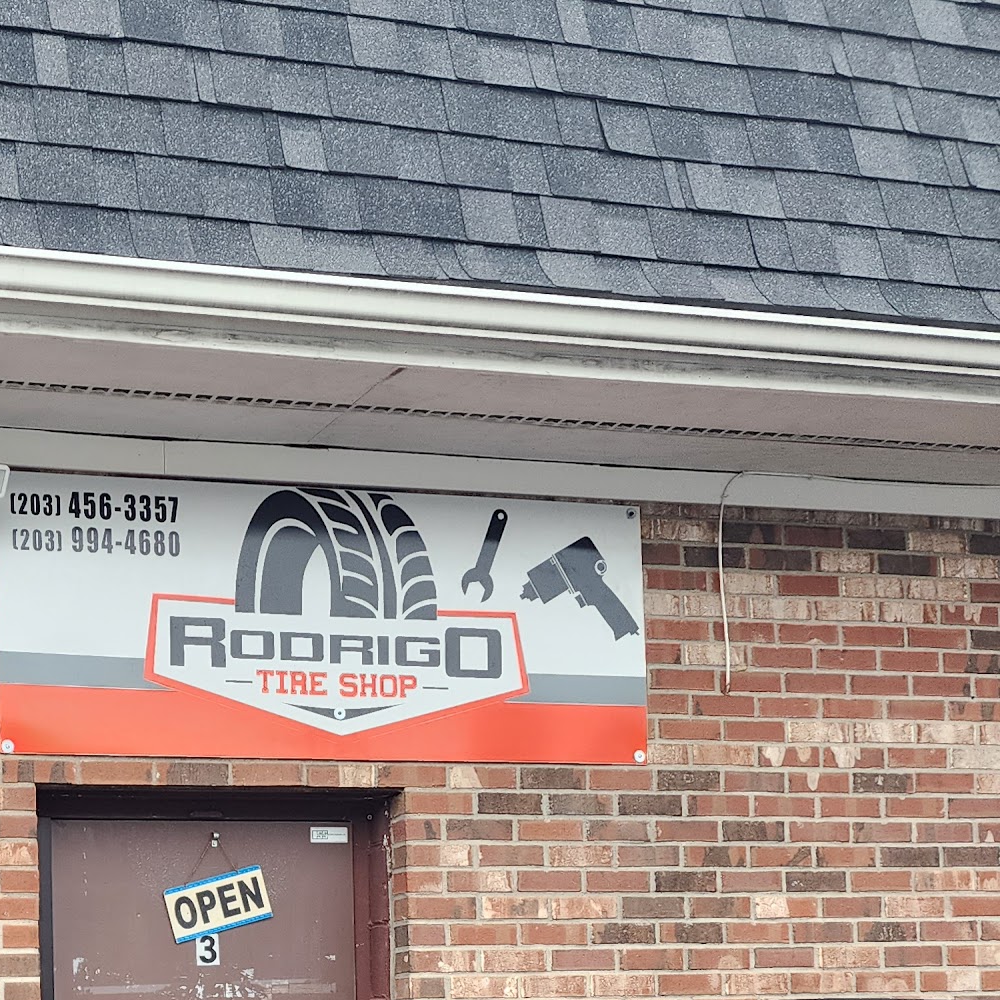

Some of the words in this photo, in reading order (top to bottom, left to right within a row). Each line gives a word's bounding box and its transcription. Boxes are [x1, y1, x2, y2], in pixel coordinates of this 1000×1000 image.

[10, 492, 61, 516] (203)
[68, 491, 179, 523] 456-3357
[12, 528, 62, 552] (203)
[71, 526, 181, 557] 994-4680
[256, 669, 328, 696] TIRE
[338, 673, 418, 698] SHOP
[174, 876, 265, 930] OPEN
[199, 935, 217, 964] 3
